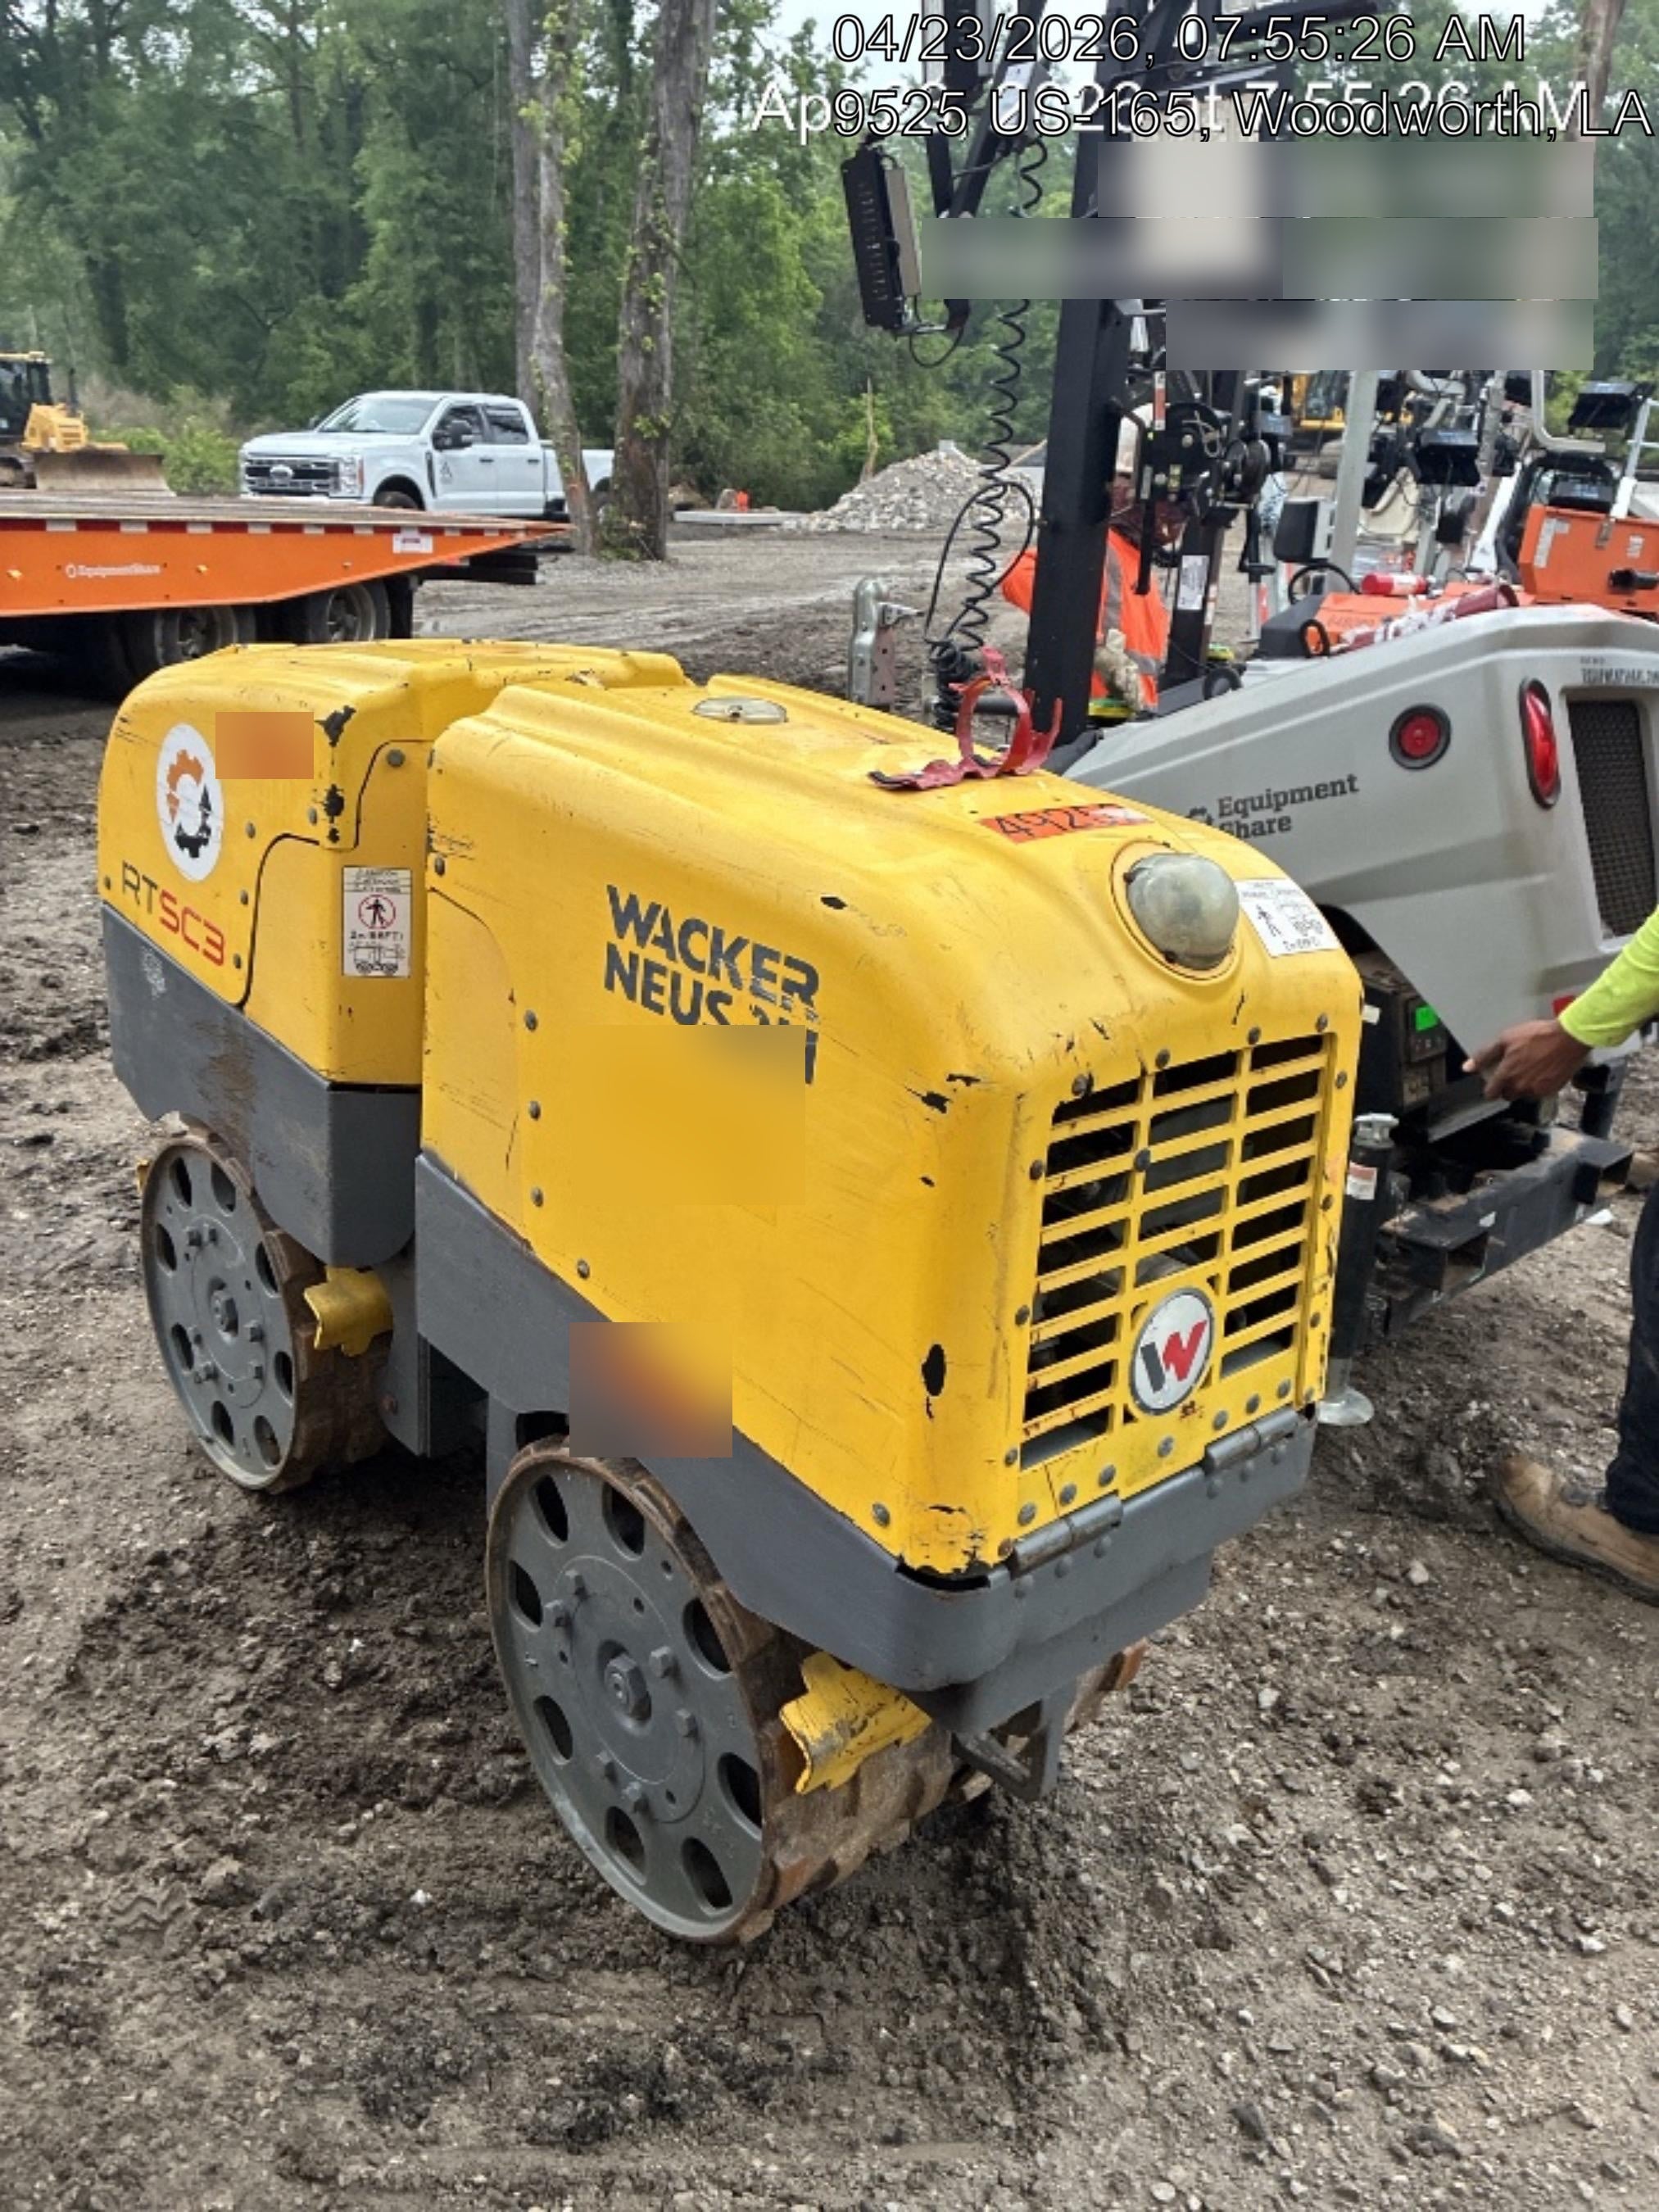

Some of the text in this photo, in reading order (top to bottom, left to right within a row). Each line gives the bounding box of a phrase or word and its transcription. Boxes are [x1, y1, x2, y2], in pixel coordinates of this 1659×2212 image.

[1217, 773, 1361, 818] Equipment
[122, 860, 225, 967] RTSC3
[606, 884, 821, 1021] WACKER
